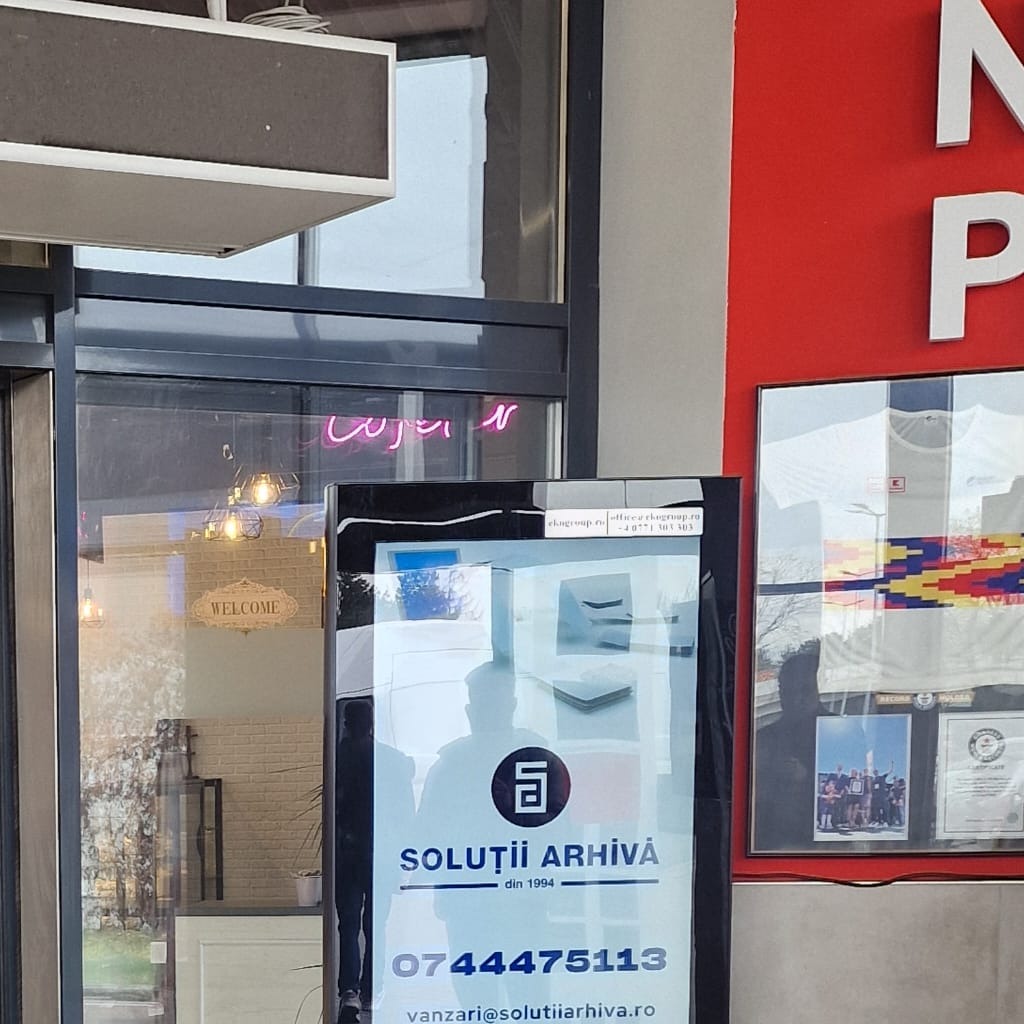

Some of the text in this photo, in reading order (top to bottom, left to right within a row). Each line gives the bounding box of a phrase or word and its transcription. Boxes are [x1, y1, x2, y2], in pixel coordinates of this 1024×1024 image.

[211, 600, 281, 616] WELCOME
[504, 878, 555, 889] din 1994
[391, 947, 668, 978] 0744475113
[407, 1002, 657, 1024] vanzari@solutiiarhiva.ro
